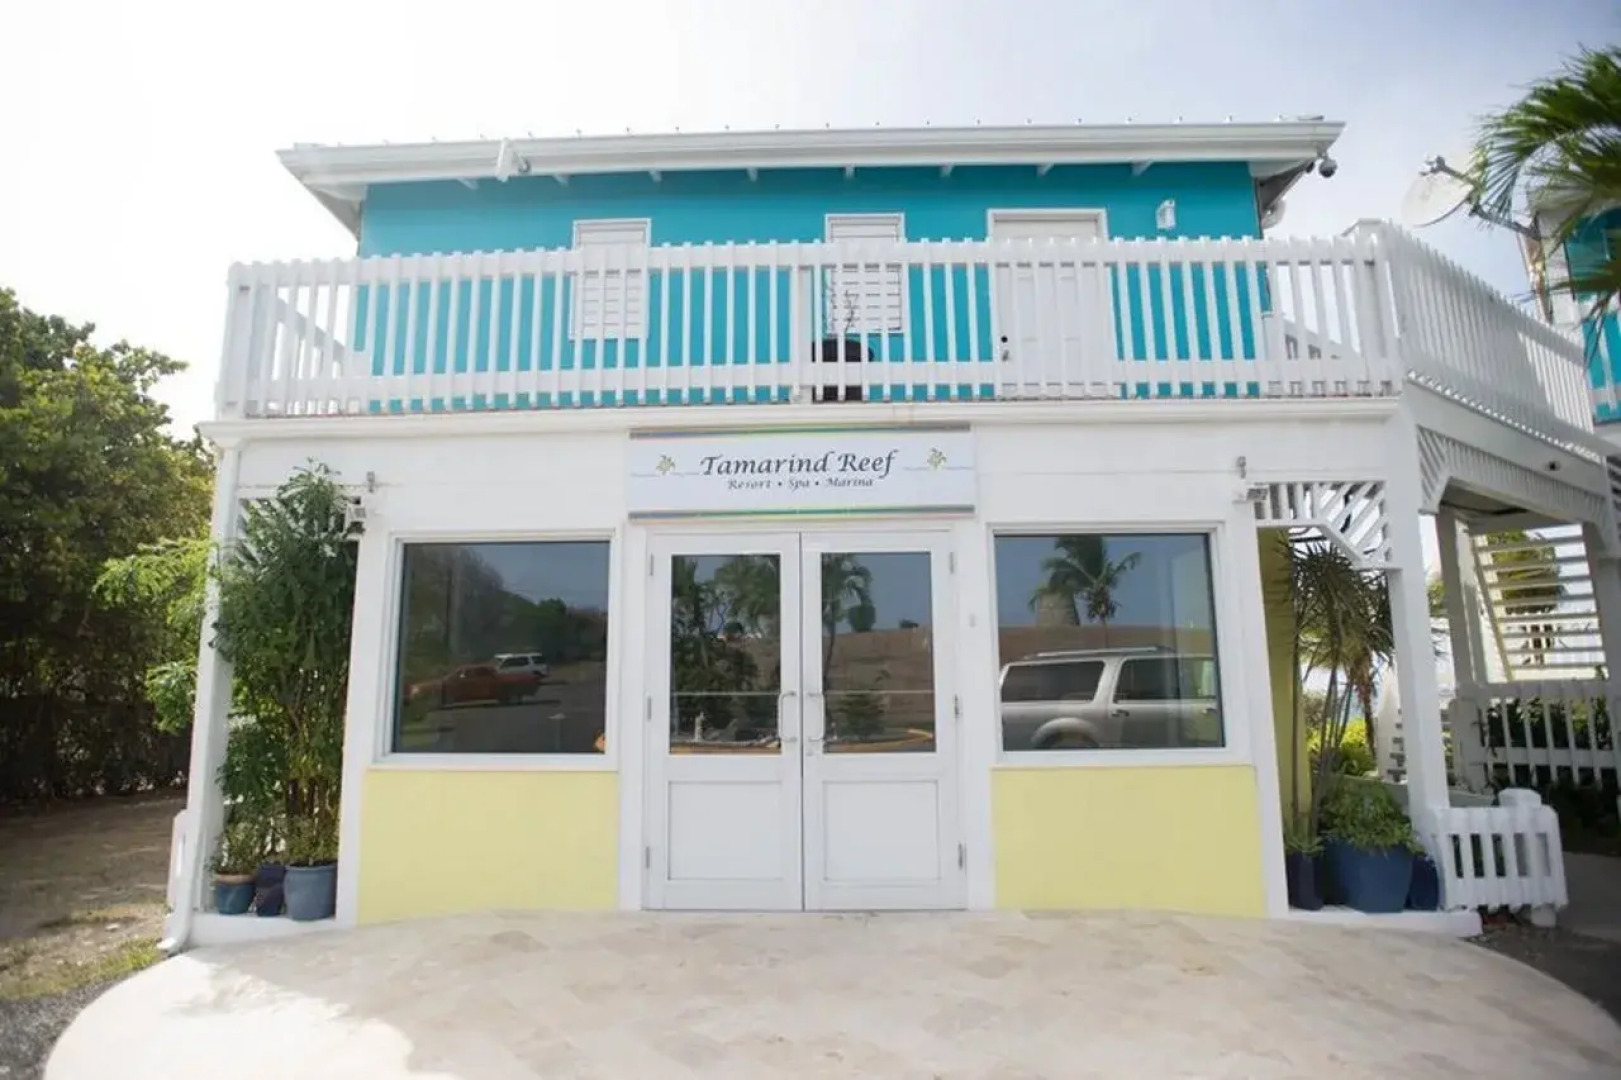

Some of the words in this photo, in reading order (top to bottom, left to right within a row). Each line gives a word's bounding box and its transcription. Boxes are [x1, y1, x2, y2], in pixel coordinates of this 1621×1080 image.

[700, 451, 834, 477] Tamarind
[837, 448, 900, 478] Reef
[728, 475, 772, 490] Resort
[787, 475, 812, 491] Spa
[825, 475, 875, 488] Marina
